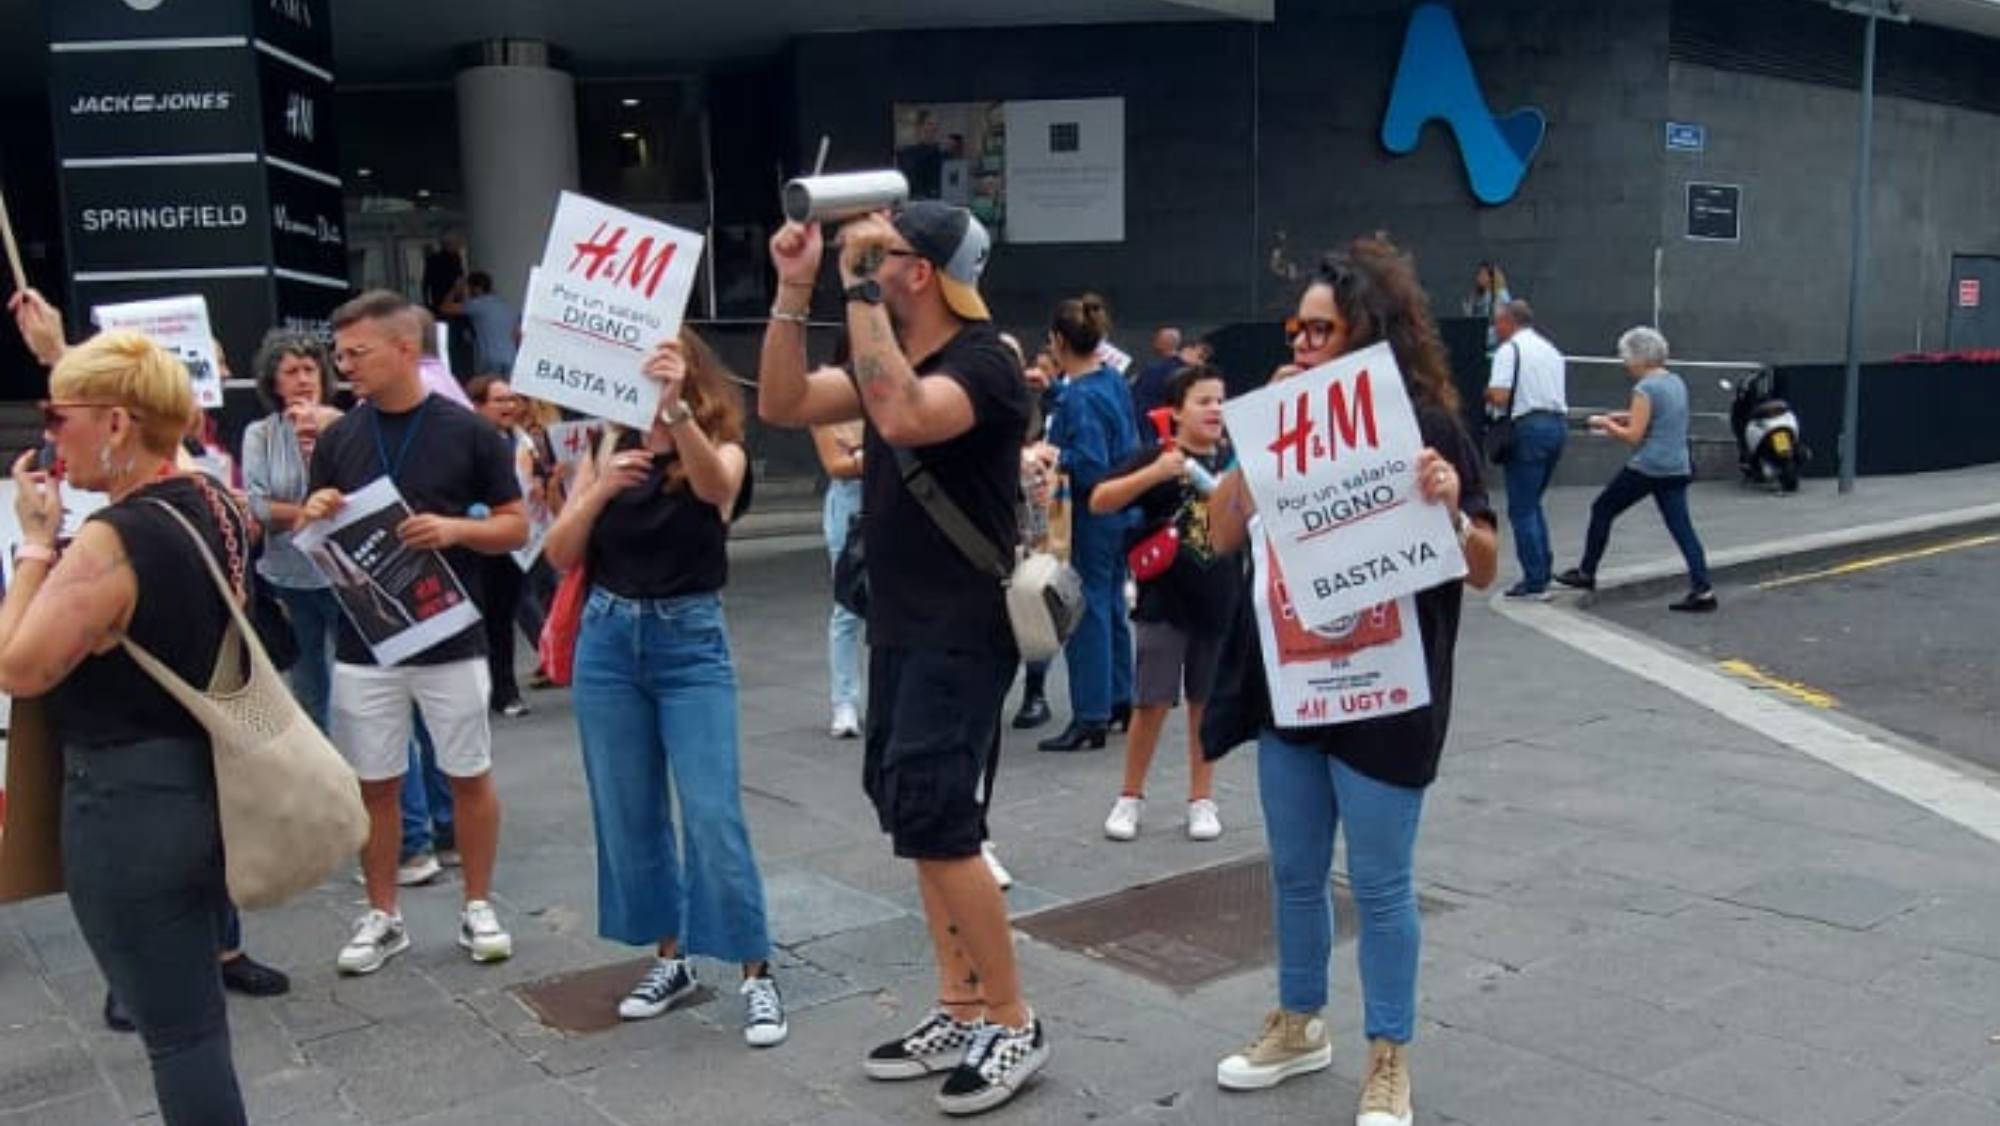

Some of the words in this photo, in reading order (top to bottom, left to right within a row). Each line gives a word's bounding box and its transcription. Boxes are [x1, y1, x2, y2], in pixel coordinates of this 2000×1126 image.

[82, 205, 247, 231] SPRINGFIELD
[567, 222, 677, 299] H&M
[563, 305, 640, 343] DIGNO
[535, 358, 606, 395] BASTA
[613, 381, 638, 405] YA
[1266, 368, 1378, 480] H&M
[1276, 495, 1308, 514] Por
[1313, 485, 1339, 501] un
[1341, 459, 1407, 490] salario
[1302, 485, 1394, 532] DIGNO
[1313, 554, 1399, 600] BASTA
[1399, 541, 1438, 577] YA
[1339, 690, 1386, 714] UGT
